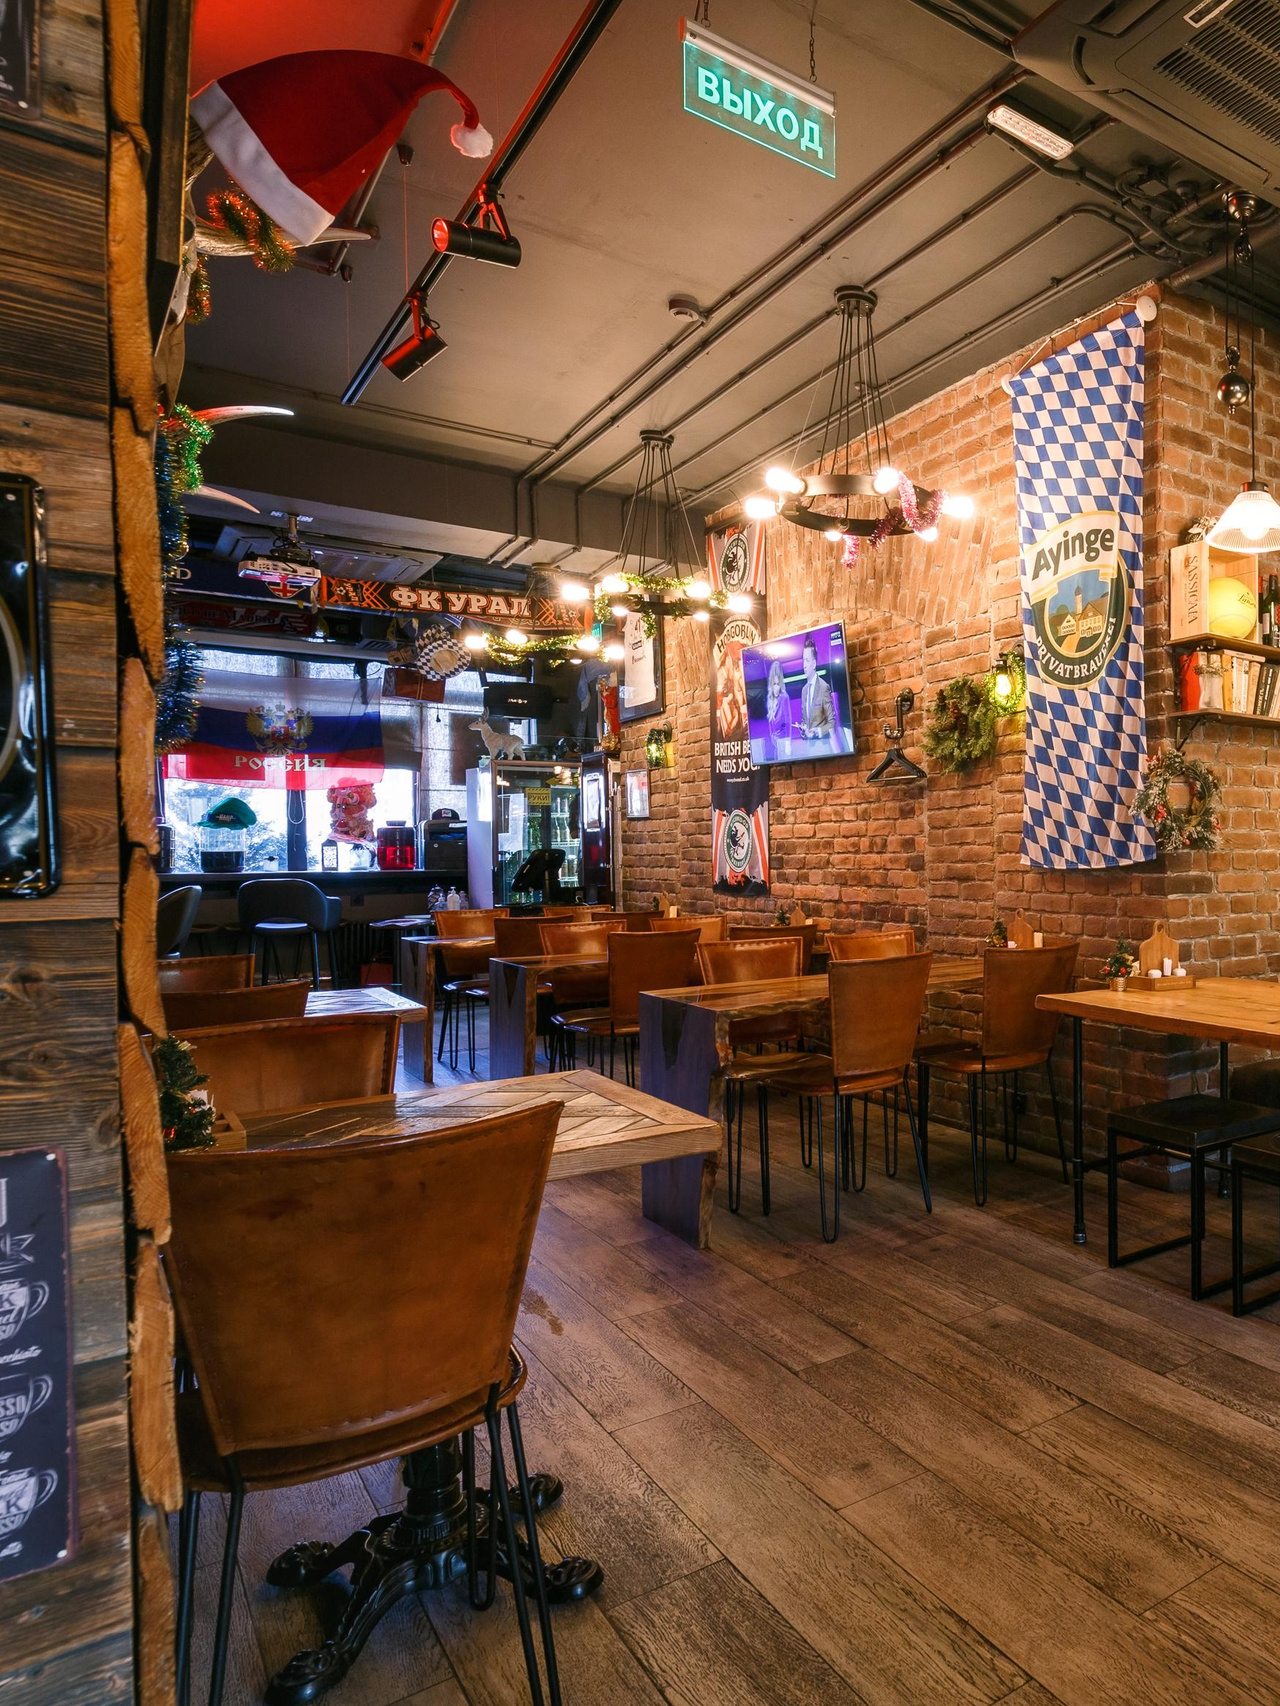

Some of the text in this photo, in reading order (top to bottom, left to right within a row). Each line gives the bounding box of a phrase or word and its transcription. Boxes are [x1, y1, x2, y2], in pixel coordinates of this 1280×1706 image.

[698, 66, 824, 160] ВЫХОД
[391, 586, 441, 611] ФК
[449, 593, 530, 617] УРАЛ
[1188, 555, 1199, 624] SASSICAIA
[716, 624, 756, 654] HOBGOBLIN
[234, 753, 328, 772] РОССИЯ
[714, 741, 741, 756] BRITISH
[716, 759, 737, 773] NEEDS
